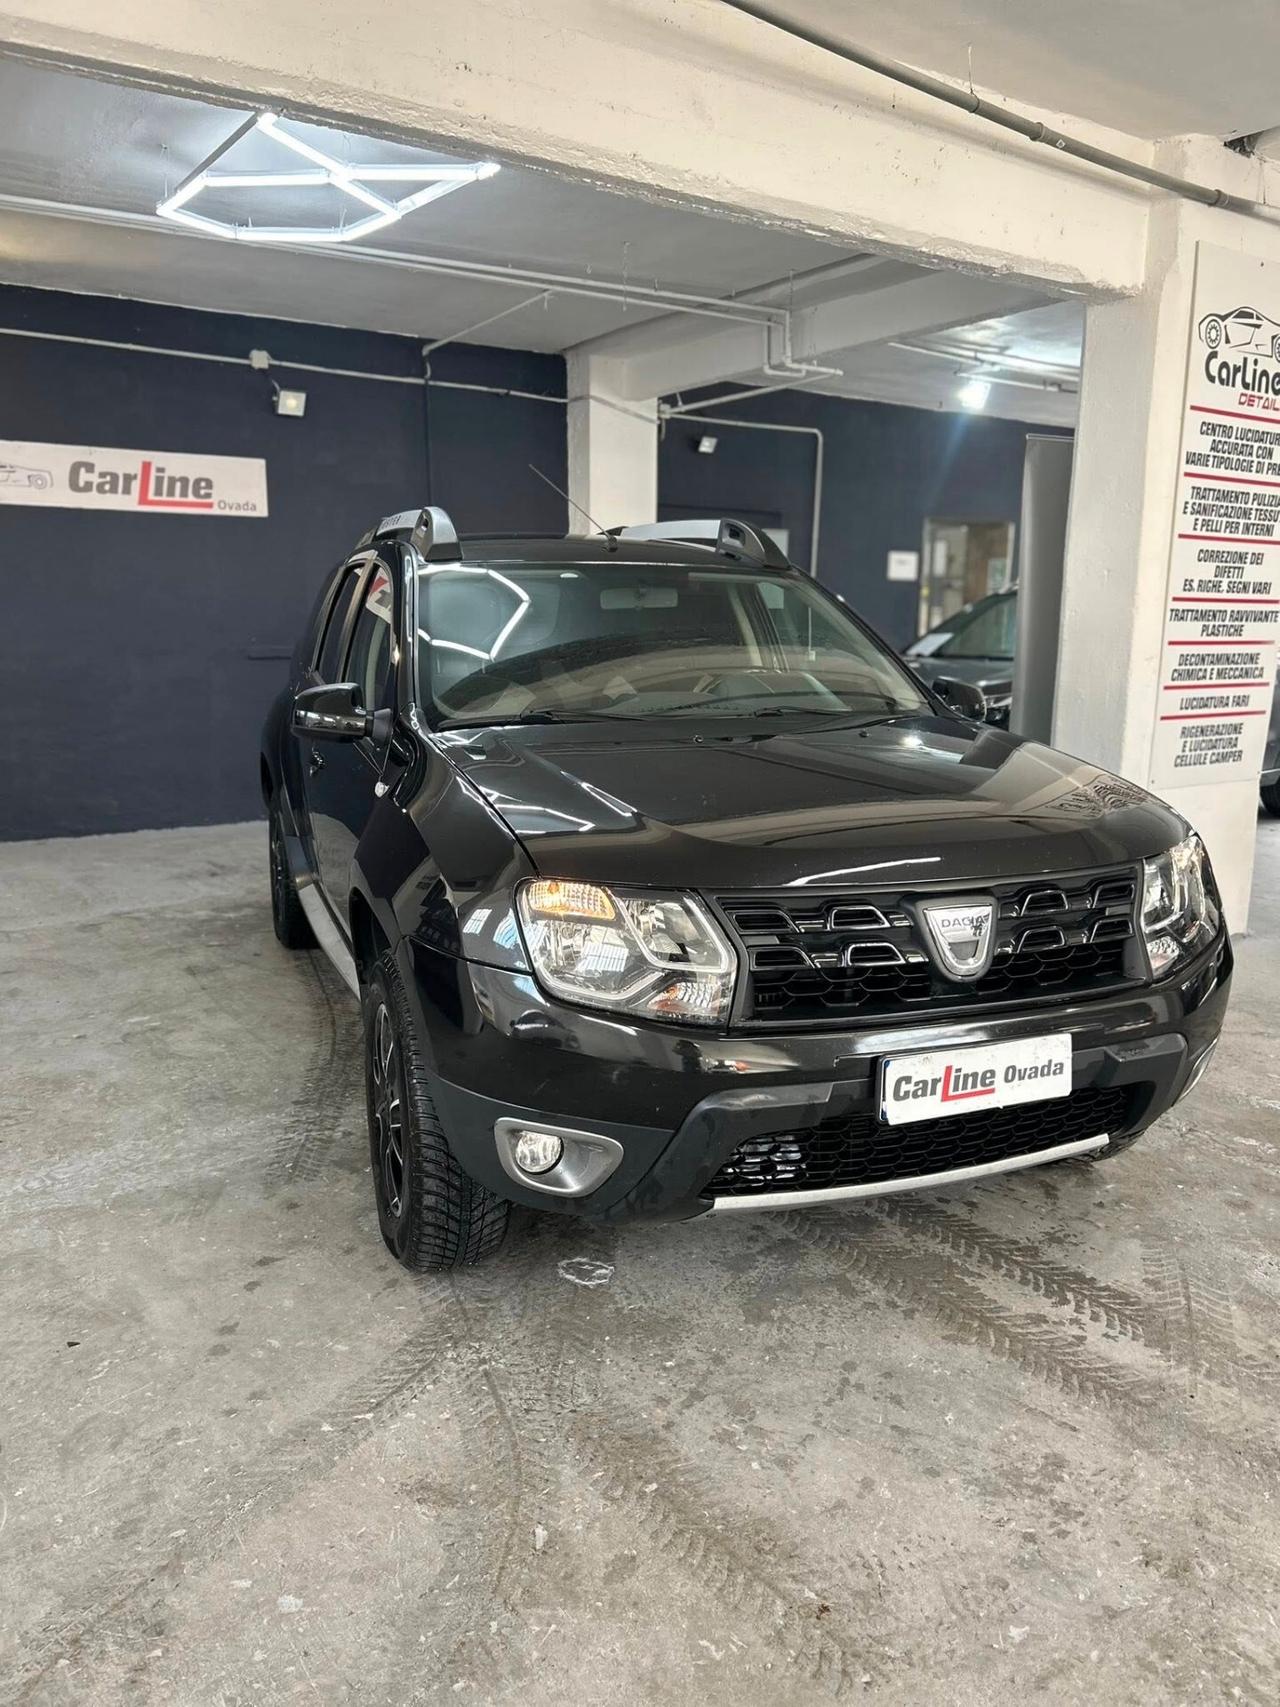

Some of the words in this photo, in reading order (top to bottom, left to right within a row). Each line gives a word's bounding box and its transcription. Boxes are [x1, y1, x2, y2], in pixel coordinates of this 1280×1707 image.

[1200, 421, 1234, 440] CENTRO
[1209, 438, 1254, 458] ACCURATA
[1256, 445, 1274, 460] CON
[1186, 451, 1210, 468] VARIE
[1211, 454, 1254, 472] TIPOLOGIE
[1255, 460, 1266, 474] DI
[68, 460, 214, 509] CarLine
[217, 500, 257, 512] Ovada
[1190, 486, 1250, 505] TRATTAMENTO
[1183, 501, 1189, 514] E
[1190, 502, 1253, 520] SANIFICAZIONE
[1193, 518, 1199, 531] E
[1200, 518, 1223, 532] PELLI
[1224, 520, 1241, 534] PER
[1241, 522, 1275, 537] INTERNI
[1197, 549, 1249, 564] CORREZIONE
[1250, 552, 1264, 566] DEI
[1214, 565, 1245, 579] DIFETTI
[1183, 579, 1195, 592] ES.
[1226, 581, 1251, 594] SEGNI
[1251, 582, 1272, 595] VARI
[1169, 608, 1227, 622] TRATTAMENTO
[1228, 609, 1279, 623] RAVVIVANTE
[1200, 624, 1244, 637] PLASTICHE
[1178, 653, 1260, 666] DECONTAMINAZIONE
[1171, 668, 1207, 681] CHIMICA
[1209, 668, 1215, 680] E
[1216, 667, 1264, 680] MECCANICA
[1180, 696, 1229, 710] LUCIDATURA
[1231, 695, 1250, 707] FARI
[1180, 723, 1243, 738] RIGENERAZIONE
[1182, 740, 1188, 753] E
[1189, 737, 1239, 752] LUCIDATURA
[1174, 753, 1208, 768] CELLULE
[1209, 750, 1243, 765] CAMPER
[893, 1065, 996, 1102] CarLine
[1004, 1059, 1064, 1084] Ovada
